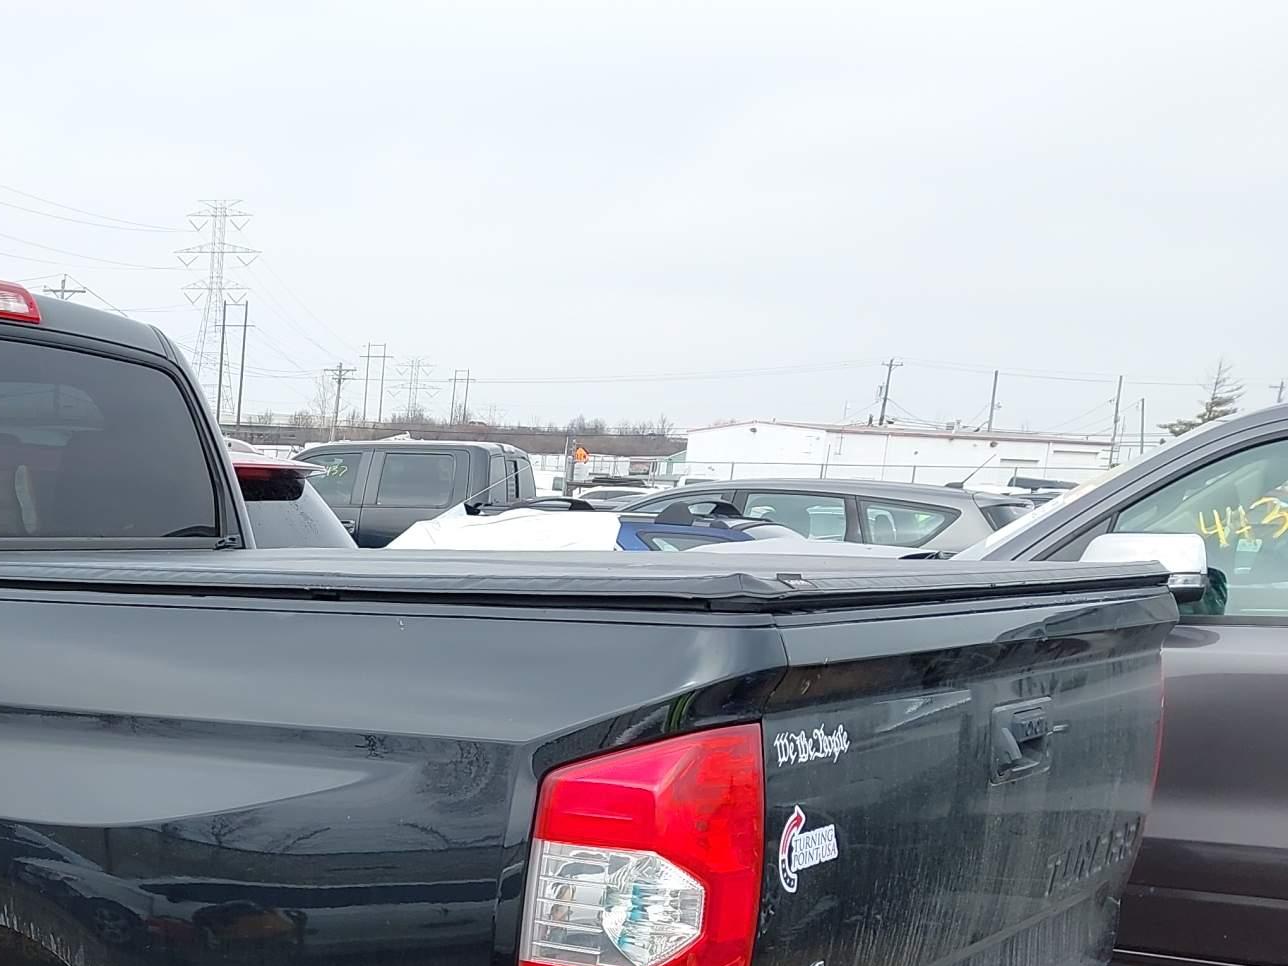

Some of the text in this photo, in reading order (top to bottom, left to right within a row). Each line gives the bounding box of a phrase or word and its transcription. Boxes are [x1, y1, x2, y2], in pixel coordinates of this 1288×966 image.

[774, 732, 796, 767] We
[813, 723, 851, 764] People
[793, 828, 834, 853] TURNING
[792, 843, 838, 869] POINT USA
